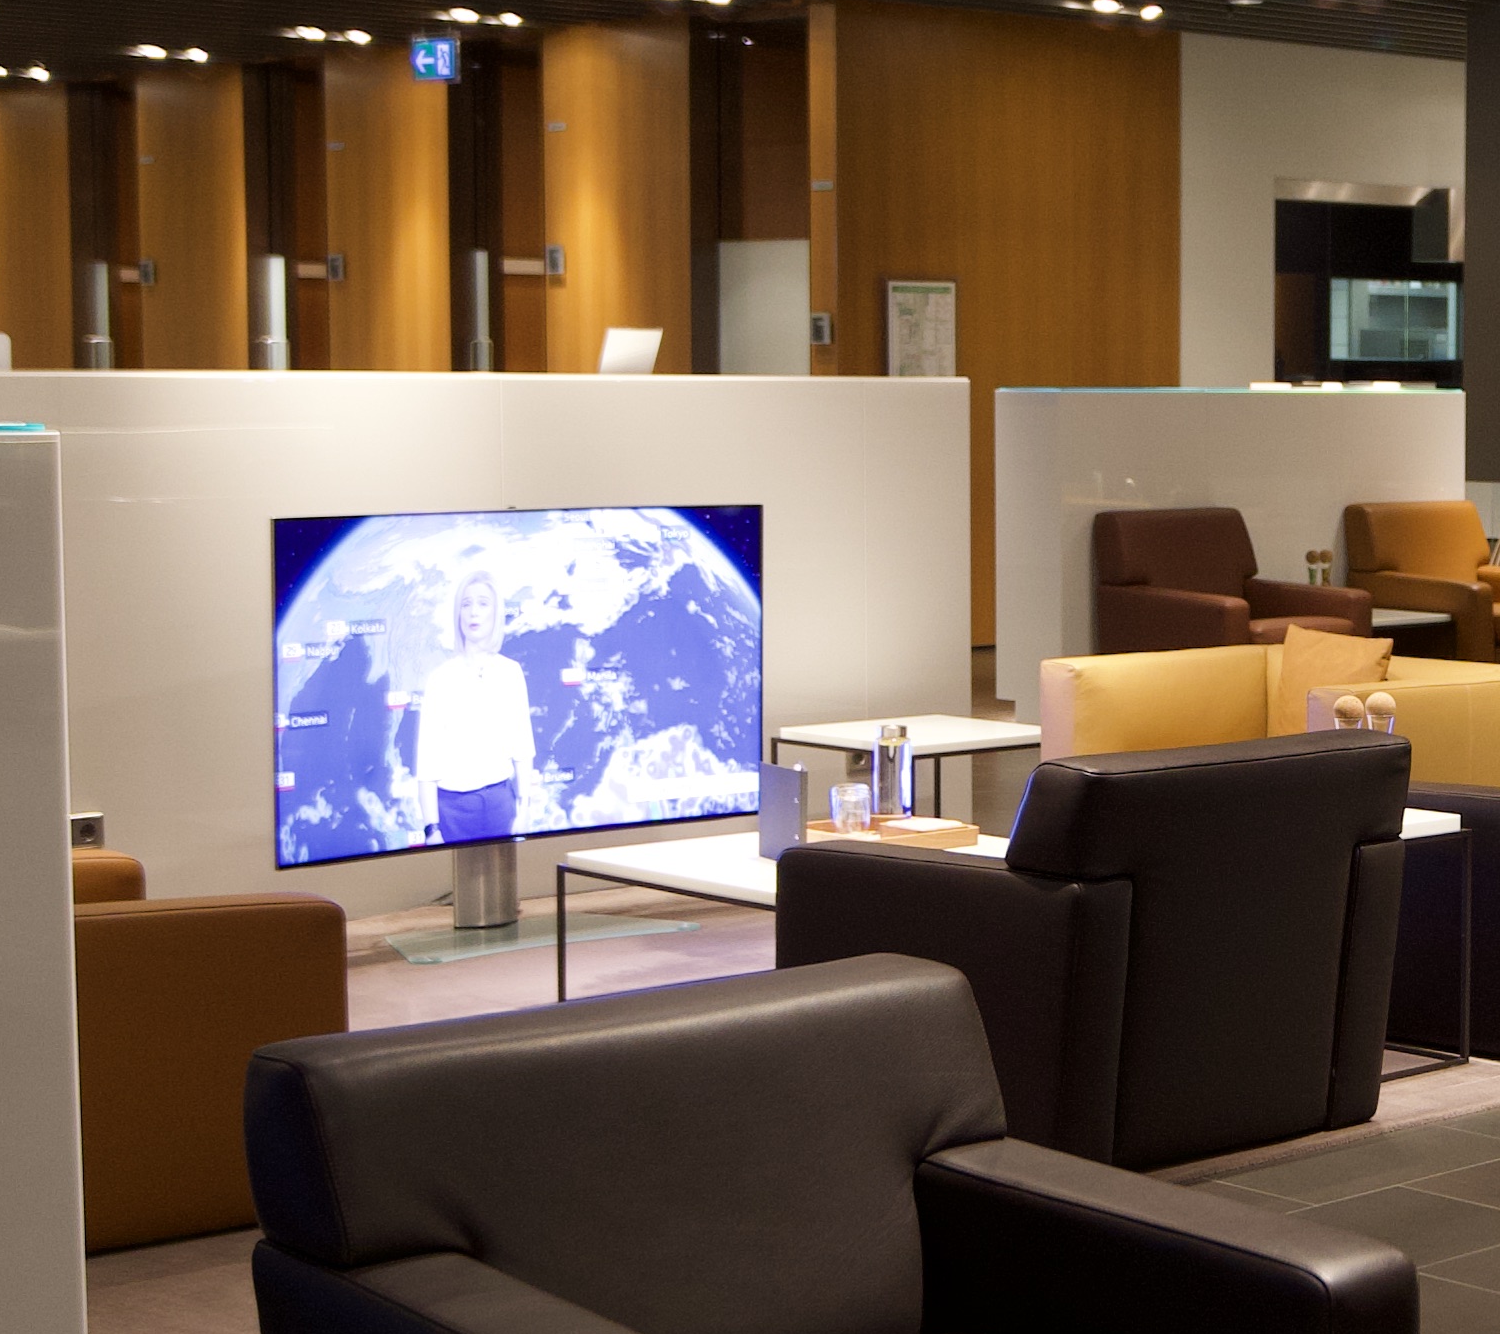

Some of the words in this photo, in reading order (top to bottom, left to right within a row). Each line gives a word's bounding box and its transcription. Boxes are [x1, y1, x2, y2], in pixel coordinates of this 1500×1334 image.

[662, 529, 689, 540] Tokyo
[350, 623, 386, 635] Kolkata
[290, 714, 328, 728] Chennai
[543, 770, 574, 783] Brunei
